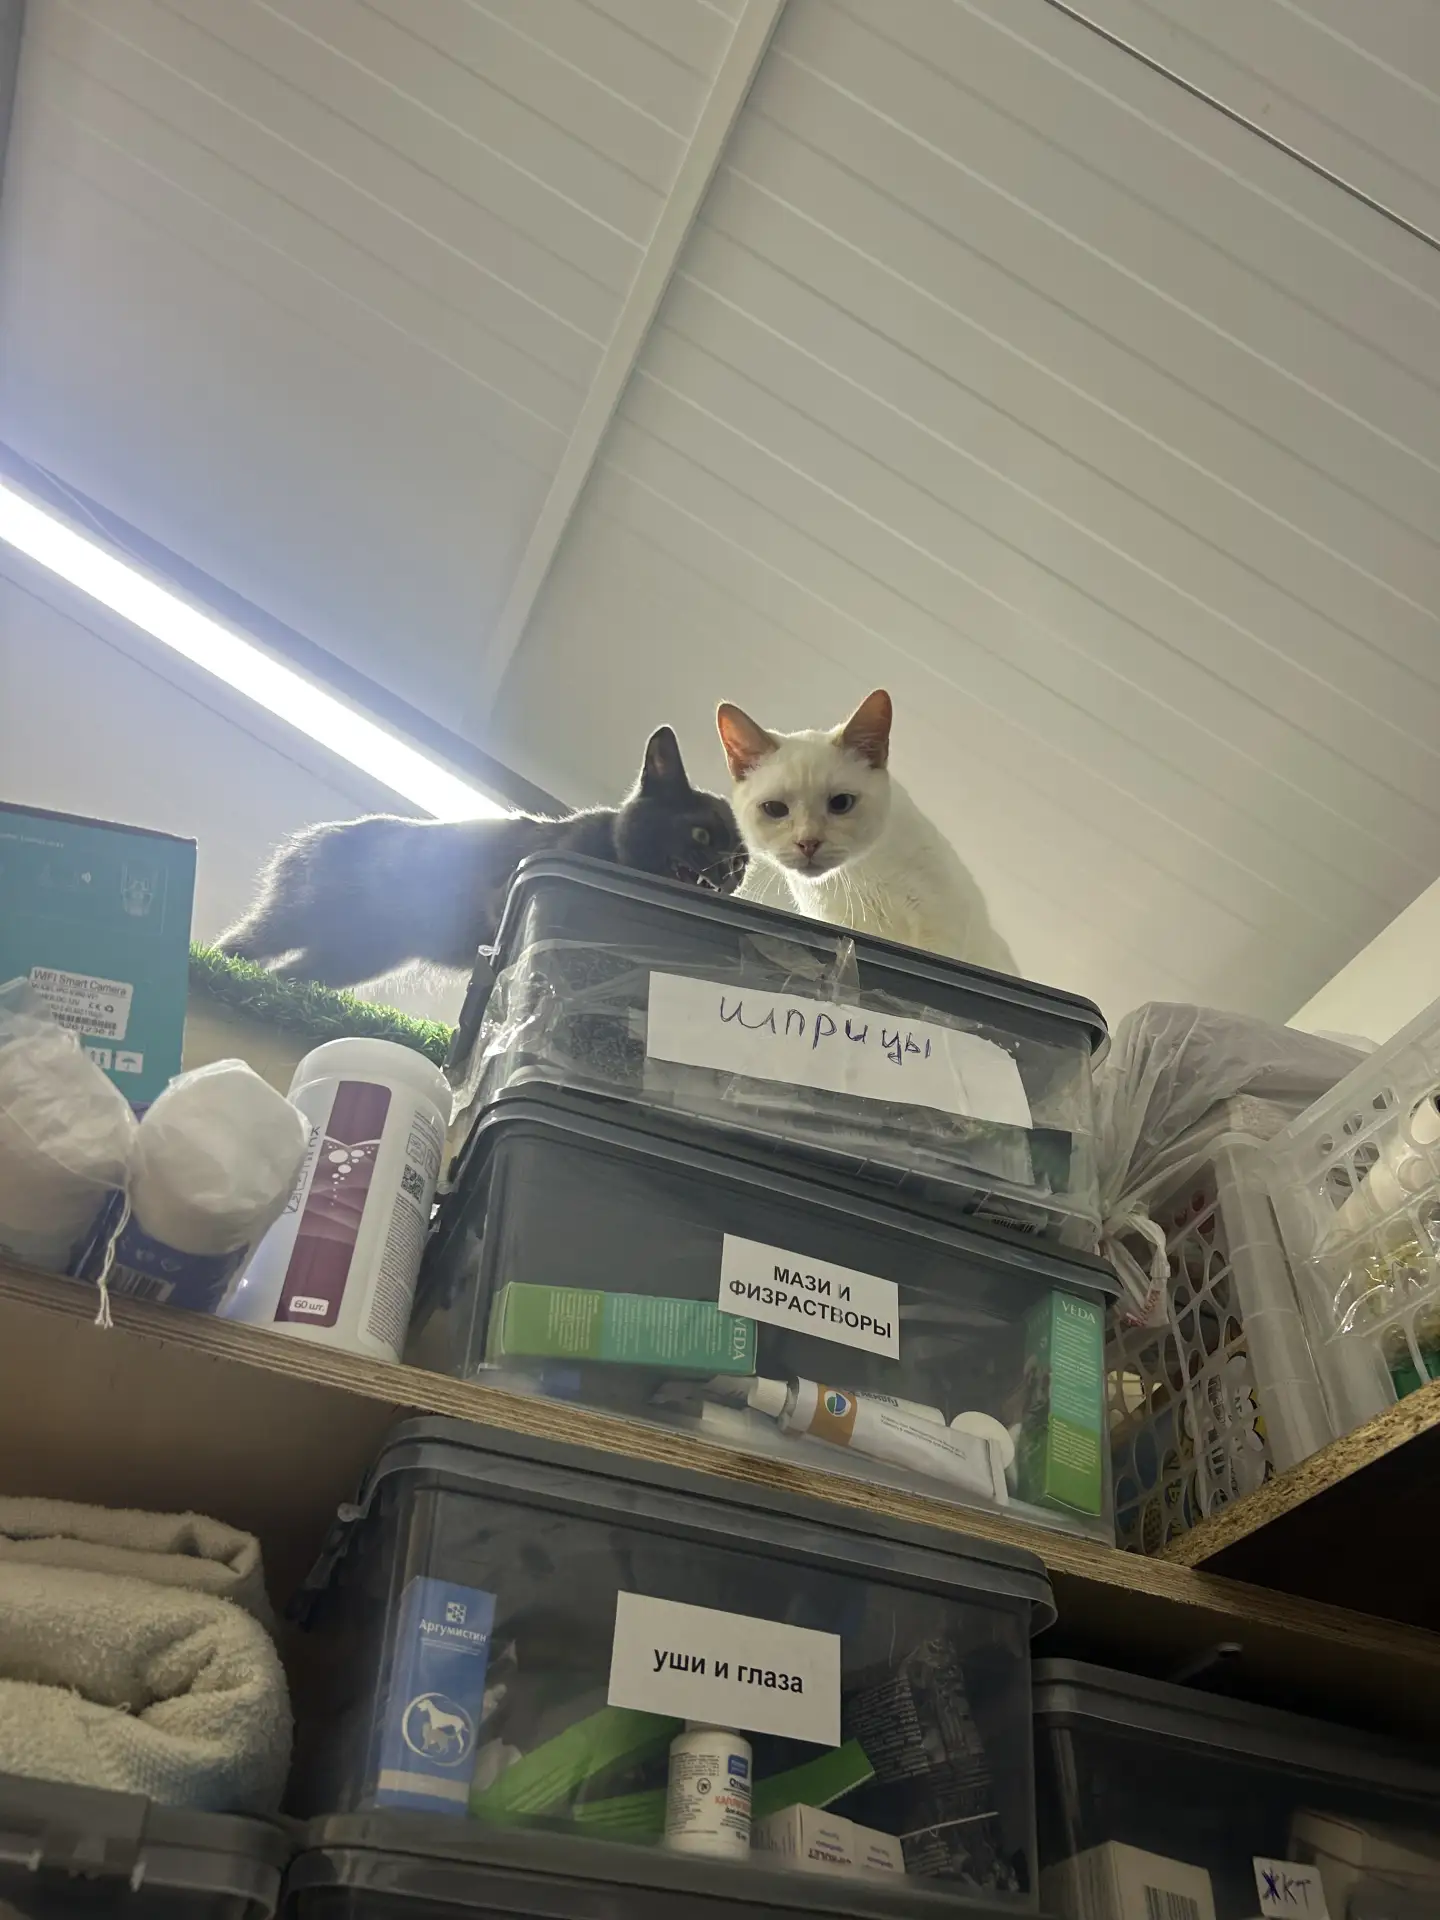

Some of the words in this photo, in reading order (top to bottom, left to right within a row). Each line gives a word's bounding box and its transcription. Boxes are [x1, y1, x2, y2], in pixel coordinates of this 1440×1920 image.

[60, 974, 88, 989] Smart
[90, 980, 128, 997] Camera
[773, 1265, 831, 1296] МАЗИ
[838, 1283, 851, 1302] И
[294, 1300, 308, 1309] 60
[309, 1303, 325, 1312] шт.
[729, 1279, 891, 1338] ФИЗРАСТВОРЫ
[1061, 1300, 1096, 1325] VEDA
[732, 1317, 747, 1361] VEDA
[418, 1618, 487, 1642] Аргумистин
[653, 1648, 706, 1675] уши
[714, 1660, 729, 1679] и
[737, 1665, 804, 1694] глаза
[1261, 1866, 1312, 1911] ЖКТ
